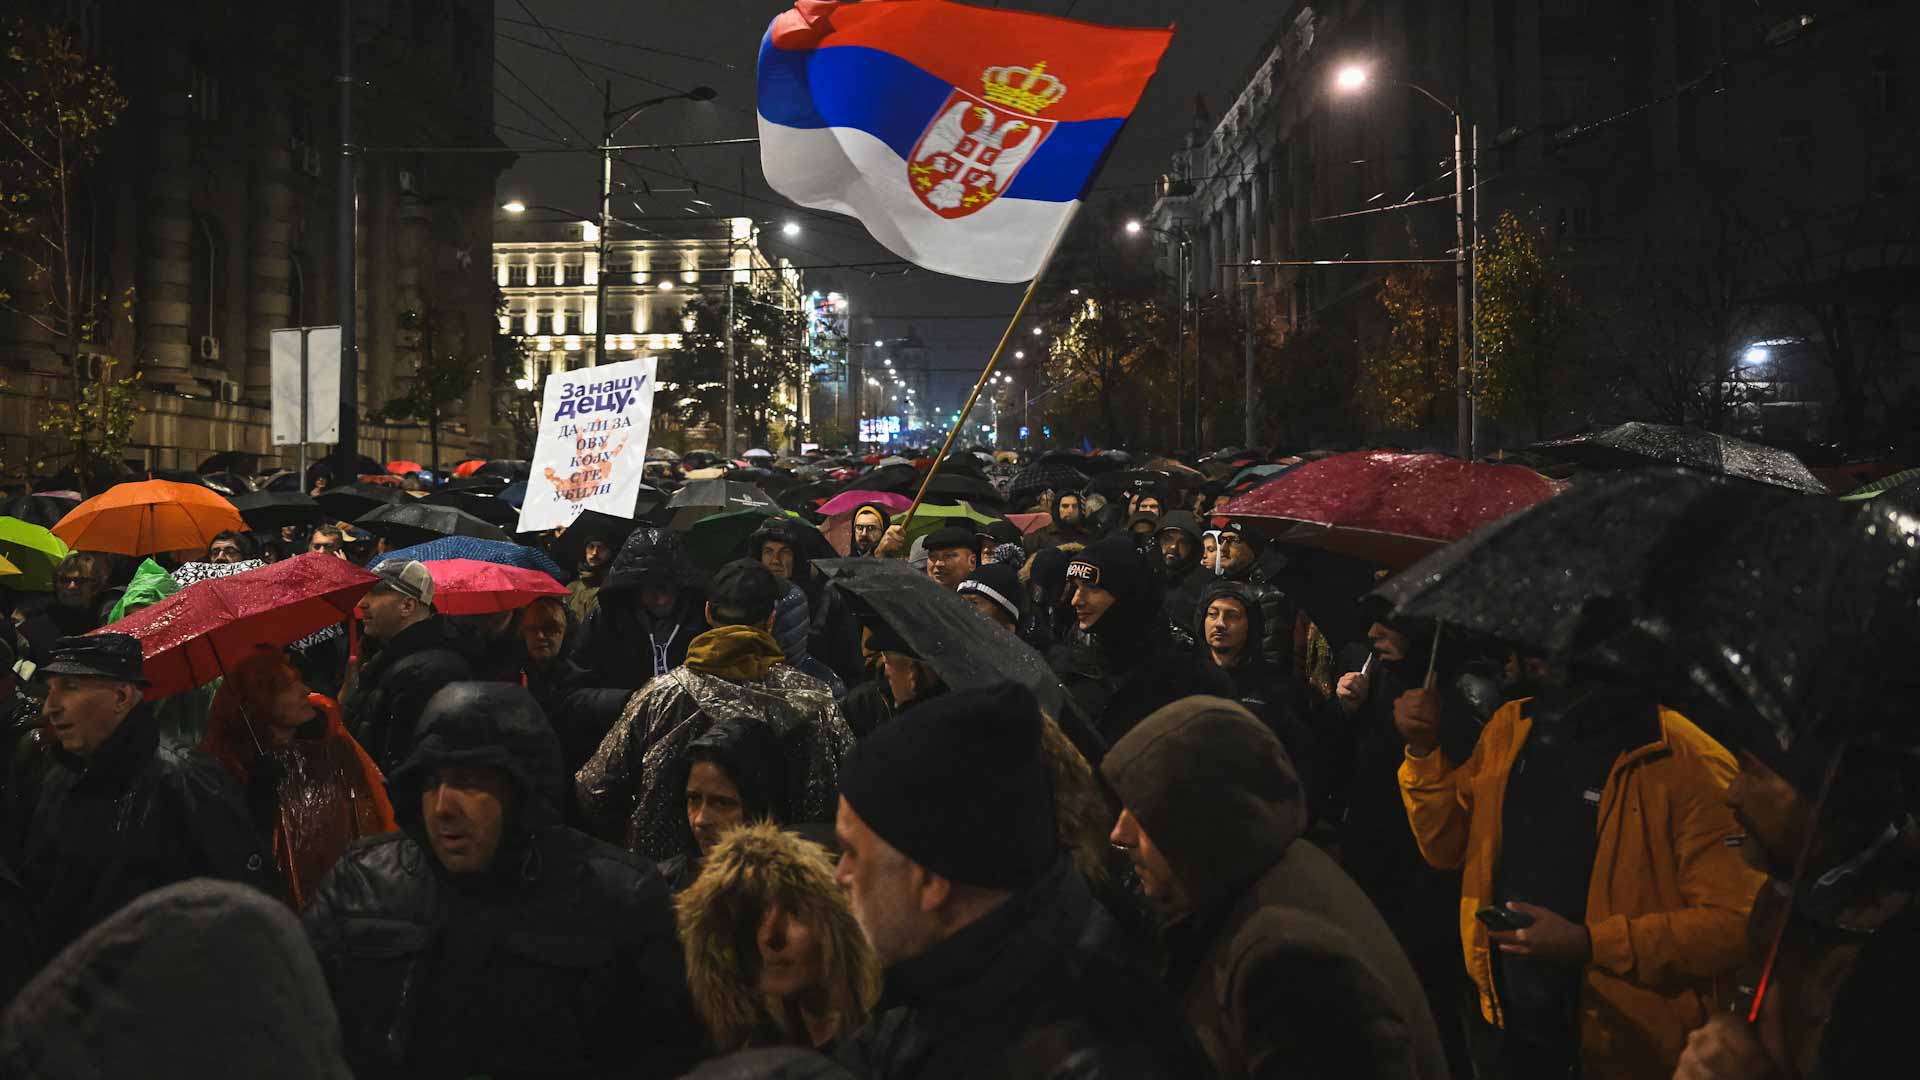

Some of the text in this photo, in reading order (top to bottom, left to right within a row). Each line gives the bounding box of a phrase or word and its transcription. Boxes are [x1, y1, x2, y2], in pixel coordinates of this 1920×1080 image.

[561, 375, 647, 399] За нашу
[554, 389, 636, 421] децу.
[559, 416, 632, 439] ДА ЛИ ЗА
[576, 435, 609, 450] ОВУ
[570, 469, 602, 484] СТЕ
[553, 483, 612, 502] УБИЛИ
[571, 503, 583, 516] ?!
